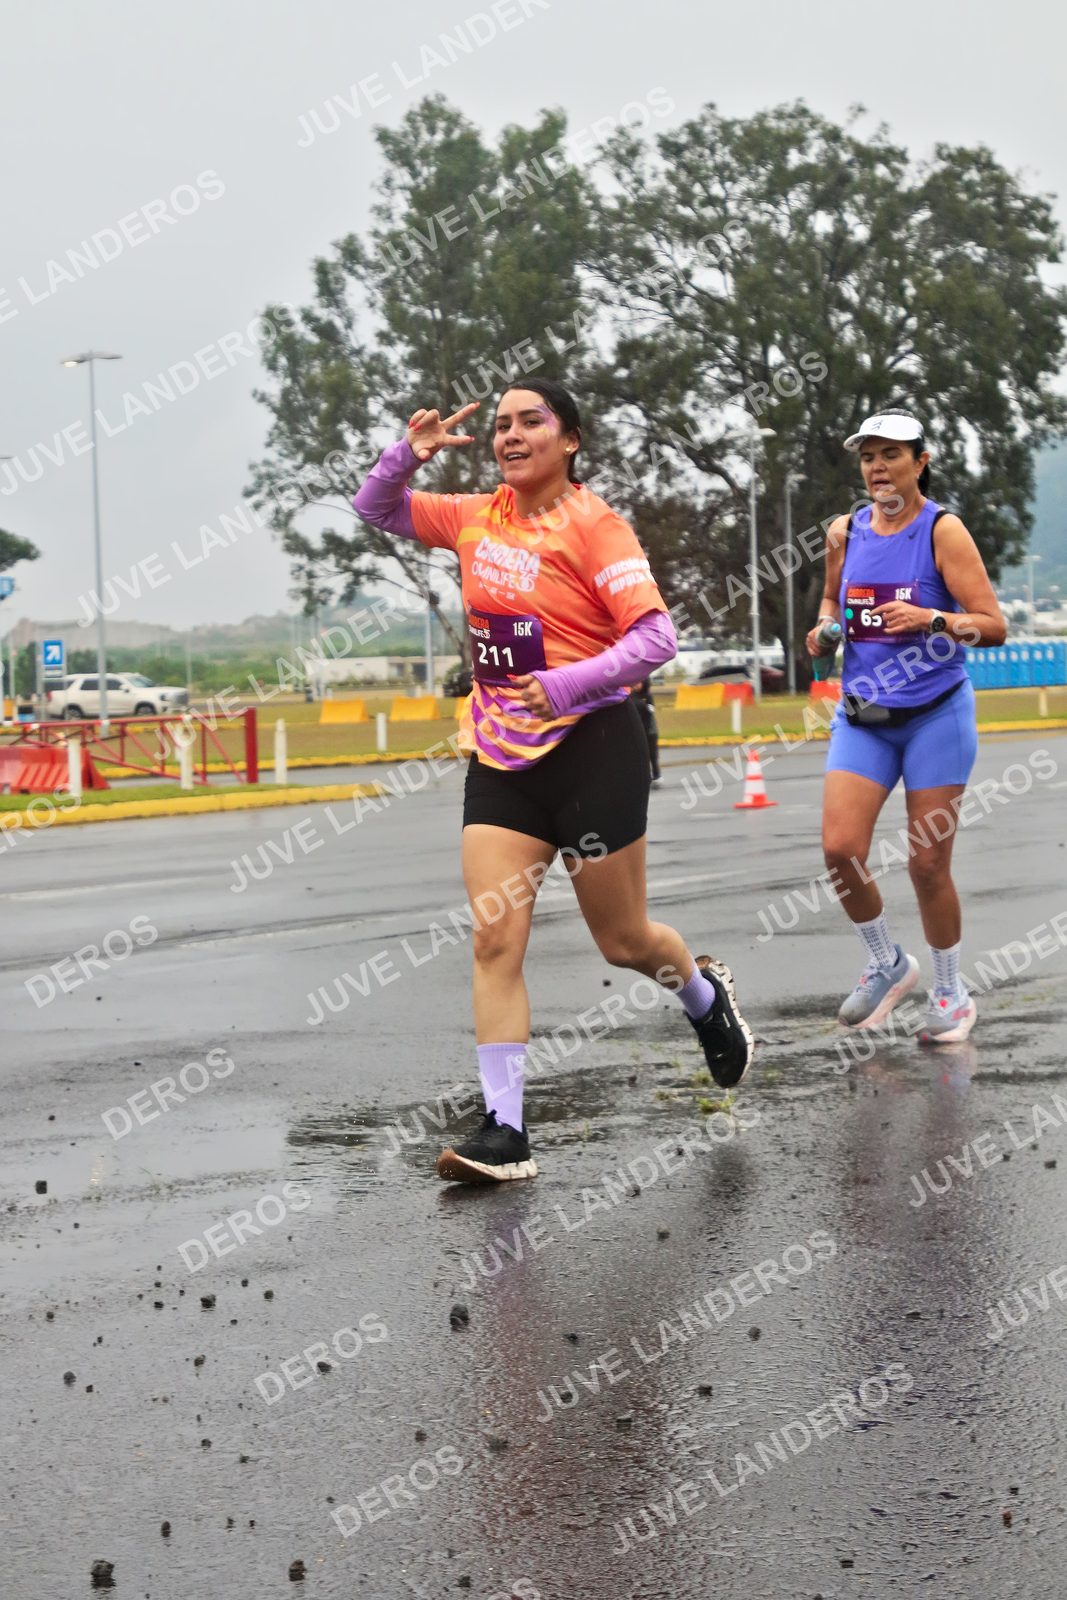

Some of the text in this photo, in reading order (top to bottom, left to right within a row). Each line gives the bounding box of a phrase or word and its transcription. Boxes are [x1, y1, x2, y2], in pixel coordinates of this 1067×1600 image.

[895, 588, 912, 600] 15K
[512, 621, 532, 637] 15K
[477, 642, 514, 667] 211
